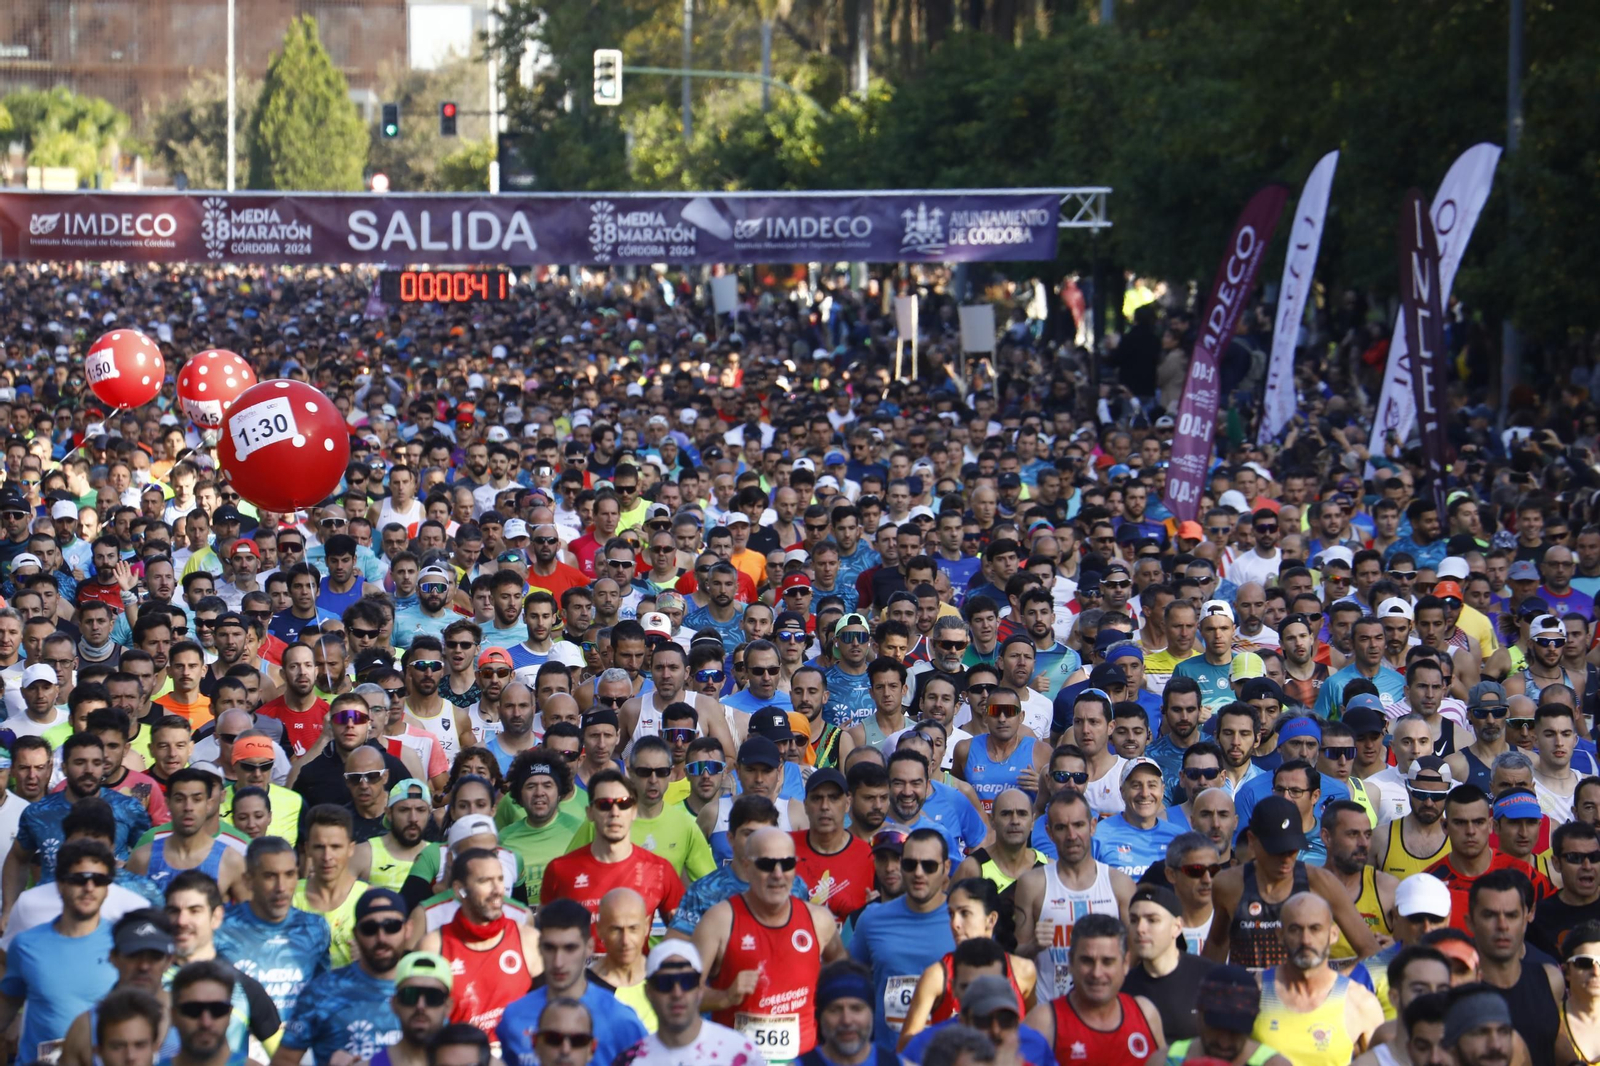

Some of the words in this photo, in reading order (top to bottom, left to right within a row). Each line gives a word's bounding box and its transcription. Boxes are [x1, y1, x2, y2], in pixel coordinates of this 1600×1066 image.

[64, 212, 178, 237] IMDECO
[231, 208, 281, 224] MEDIA
[617, 212, 666, 226] MEDIA
[948, 209, 1050, 228] AYUNTAMIENTO
[200, 219, 230, 241] 38
[231, 219, 312, 240] MARATÓN
[347, 210, 538, 251] SALIDA
[588, 222, 618, 244] 38
[617, 222, 696, 242] MARATÓN
[766, 216, 872, 239] IMDECO
[949, 228, 967, 245] DE
[231, 241, 280, 254] CÓRDOBA
[284, 243, 312, 254] 2024
[617, 244, 666, 256] CÓRDOBA
[669, 246, 696, 256] 2024
[1203, 225, 1256, 350] DECO
[87, 360, 112, 380] 1:50
[238, 413, 289, 448] 1:30
[850, 708, 877, 719] MEDIA
[257, 969, 302, 983] MEDIA
[264, 983, 305, 996] ARAT
[758, 986, 809, 1008] CORREDORES
[900, 989, 912, 1006] 6
[770, 1002, 790, 1016] CON
[754, 1029, 790, 1046] 568
